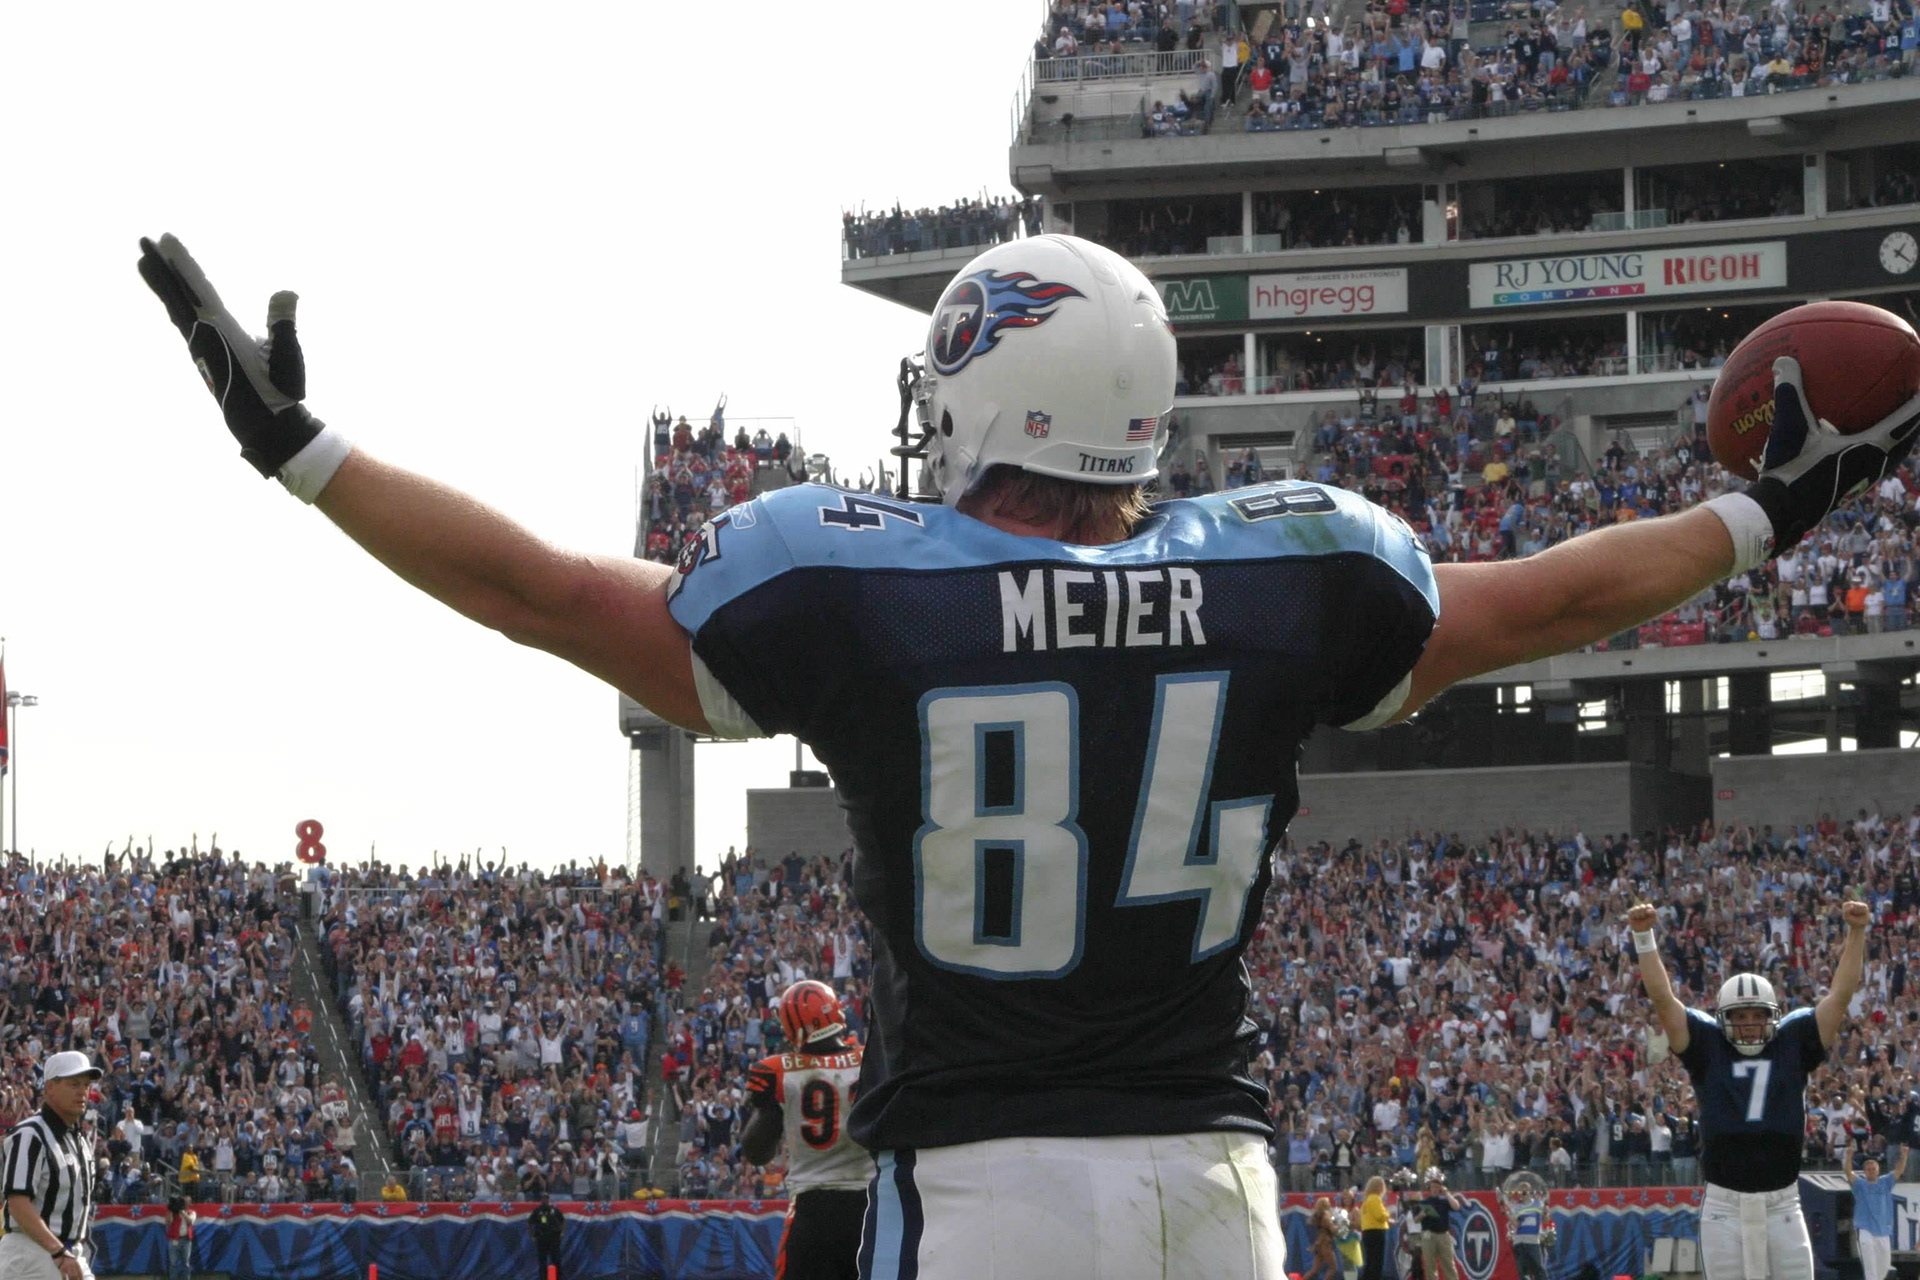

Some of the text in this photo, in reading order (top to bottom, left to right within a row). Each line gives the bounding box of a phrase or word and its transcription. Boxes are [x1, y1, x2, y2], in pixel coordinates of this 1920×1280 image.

[1494, 254, 1644, 290] RJ YOUNG
[1663, 253, 1760, 286] RICOH
[1256, 283, 1375, 315] hhgregg
[1499, 284, 1641, 303] COMPANY
[1169, 313, 1216, 321] AGEMENT
[1026, 420, 1048, 438] NFL
[1079, 452, 1136, 473] TITANS
[817, 493, 925, 532] 4
[1226, 486, 1341, 524] 8
[998, 567, 1208, 654] MEIER
[295, 819, 327, 864] 8
[913, 670, 1276, 981] 84
[781, 1050, 864, 1070] GEATHE
[1731, 1059, 1772, 1122] 7
[466, 1120, 475, 1133] 9
[800, 1079, 860, 1150] 9
[1613, 1123, 1623, 1141] 9
